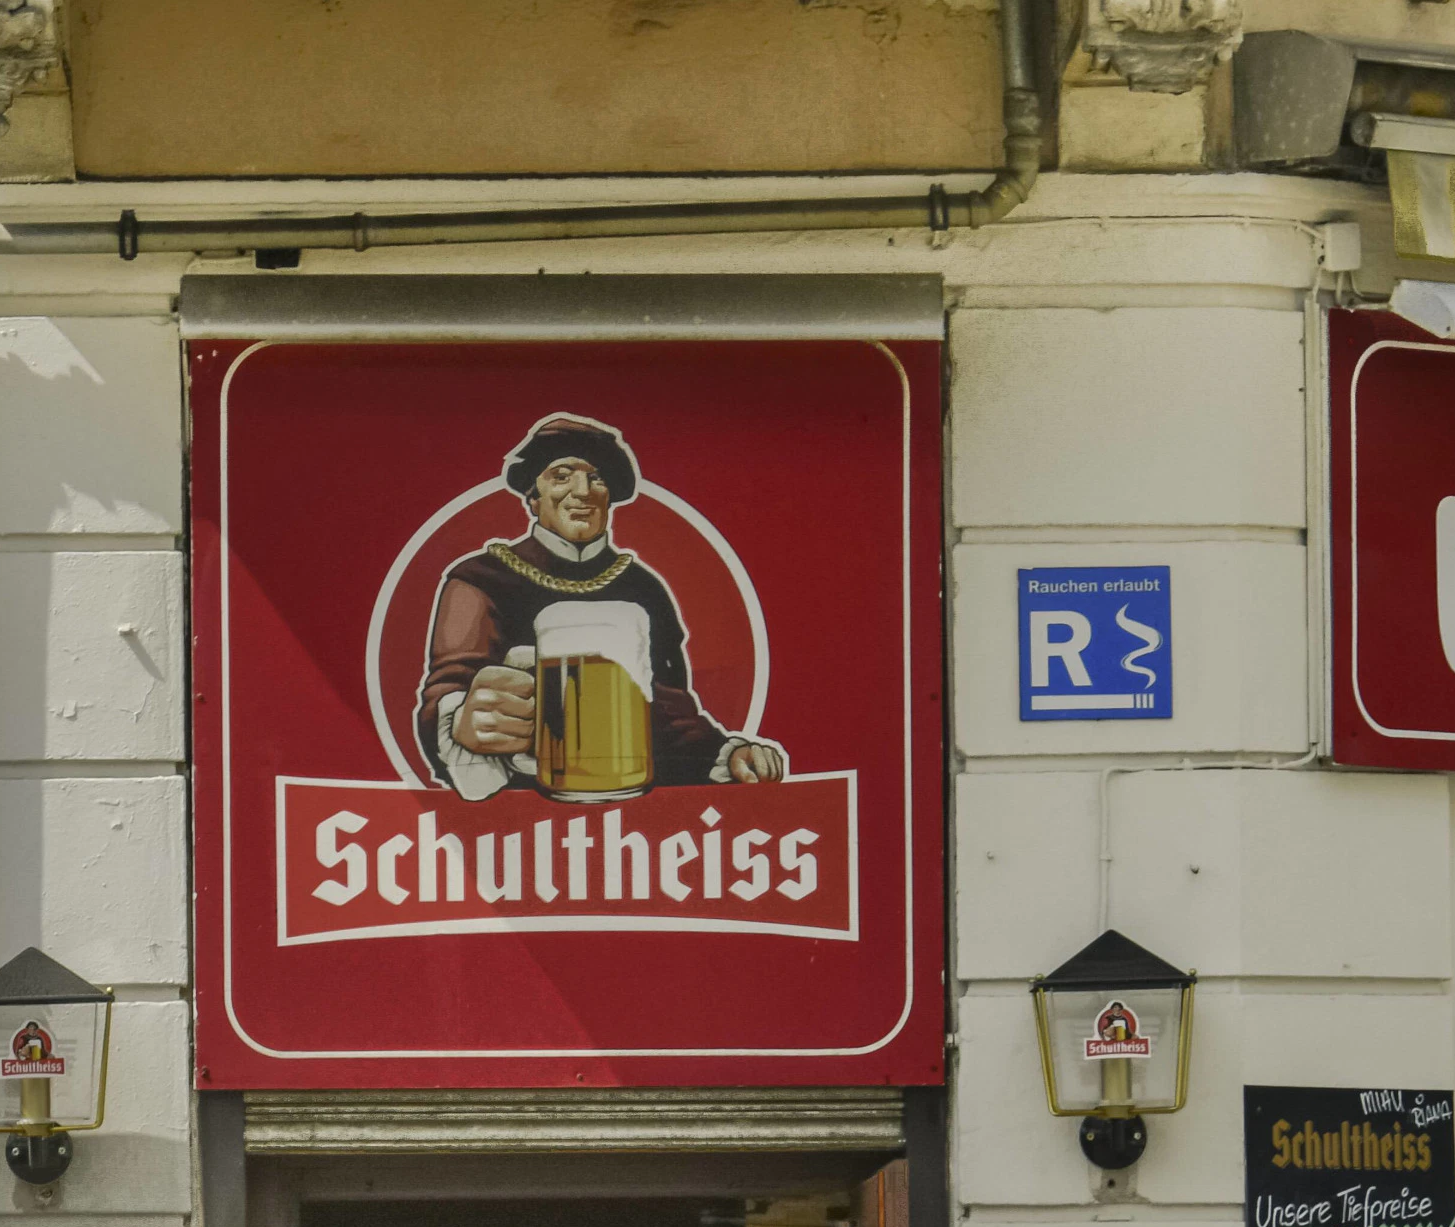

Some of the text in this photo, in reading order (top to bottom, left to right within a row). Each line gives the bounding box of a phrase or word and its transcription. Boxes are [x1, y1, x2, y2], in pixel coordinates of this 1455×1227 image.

[1028, 578, 1161, 593] Rauchen erlaubt
[1030, 610, 1093, 687] R
[311, 805, 821, 906] Schultheiss
[1088, 1040, 1146, 1054] Schultheiss
[4, 1059, 63, 1074] Schultheiss
[1271, 1118, 1432, 1170] Schultheiss
